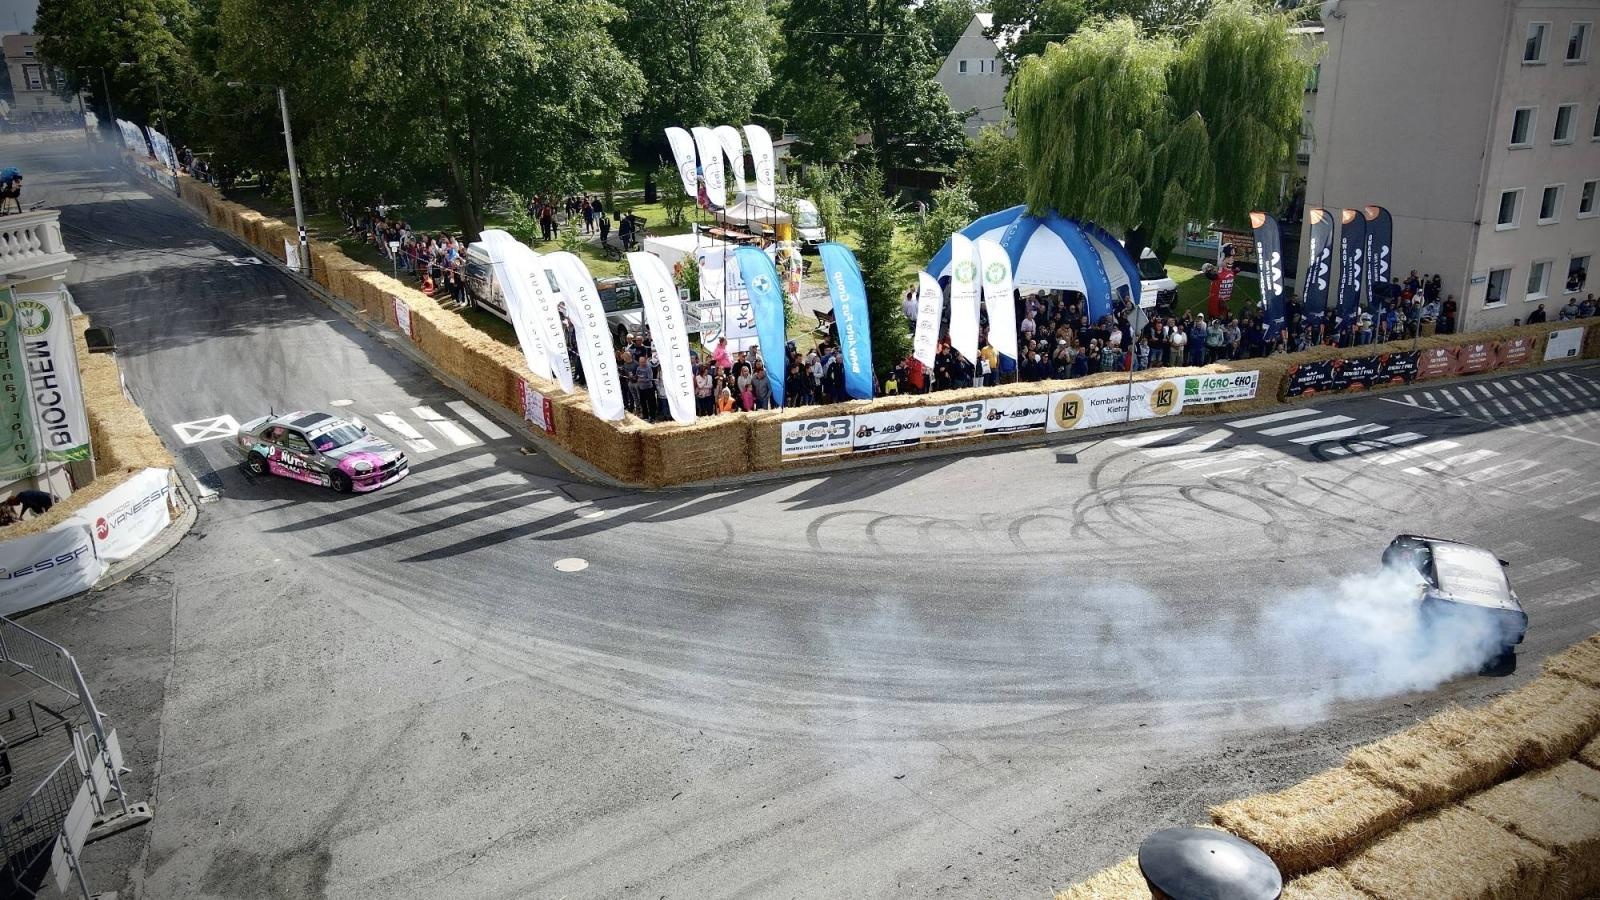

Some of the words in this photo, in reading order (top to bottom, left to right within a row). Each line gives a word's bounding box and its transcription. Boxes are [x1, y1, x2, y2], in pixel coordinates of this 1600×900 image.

[1202, 375, 1251, 389] AGRO-EKO
[1090, 395, 1125, 407] Kombinat
[924, 403, 983, 429] JCB
[785, 418, 852, 445] JCB
